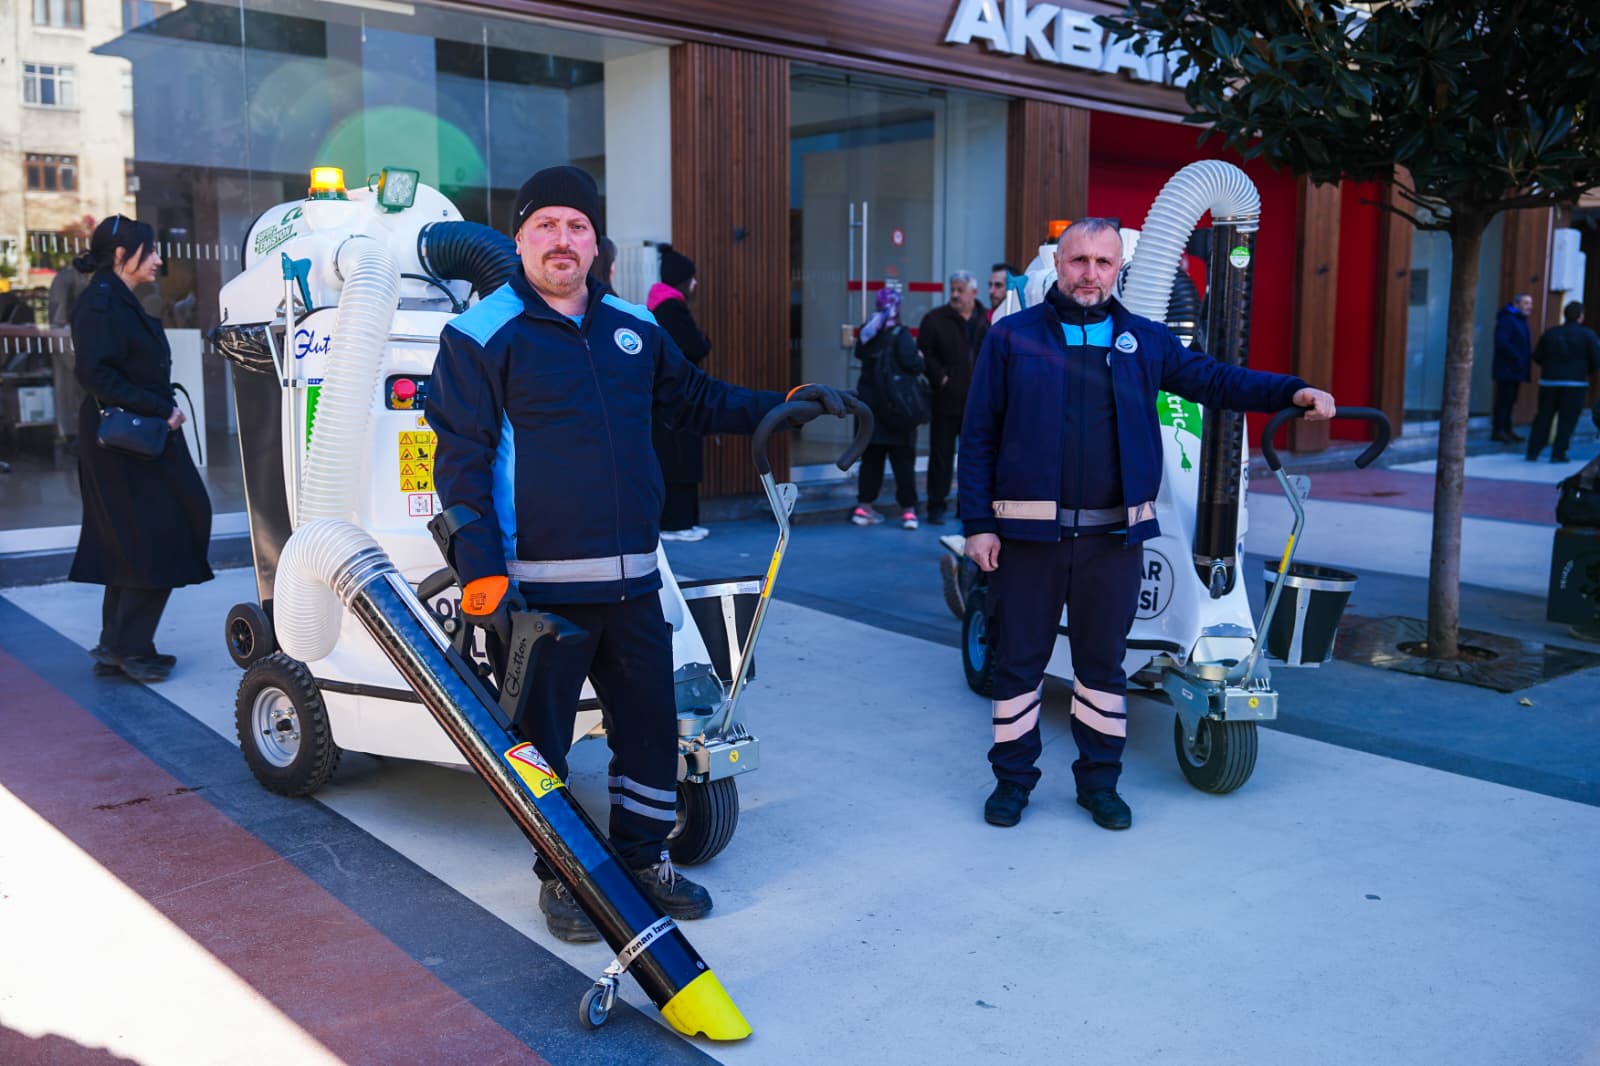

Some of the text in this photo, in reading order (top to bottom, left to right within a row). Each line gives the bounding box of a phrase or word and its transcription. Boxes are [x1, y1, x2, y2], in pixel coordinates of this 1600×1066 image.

[1165, 392, 1190, 428] tric
[505, 638, 527, 698] Glutton
[624, 932, 654, 957] Yanan
